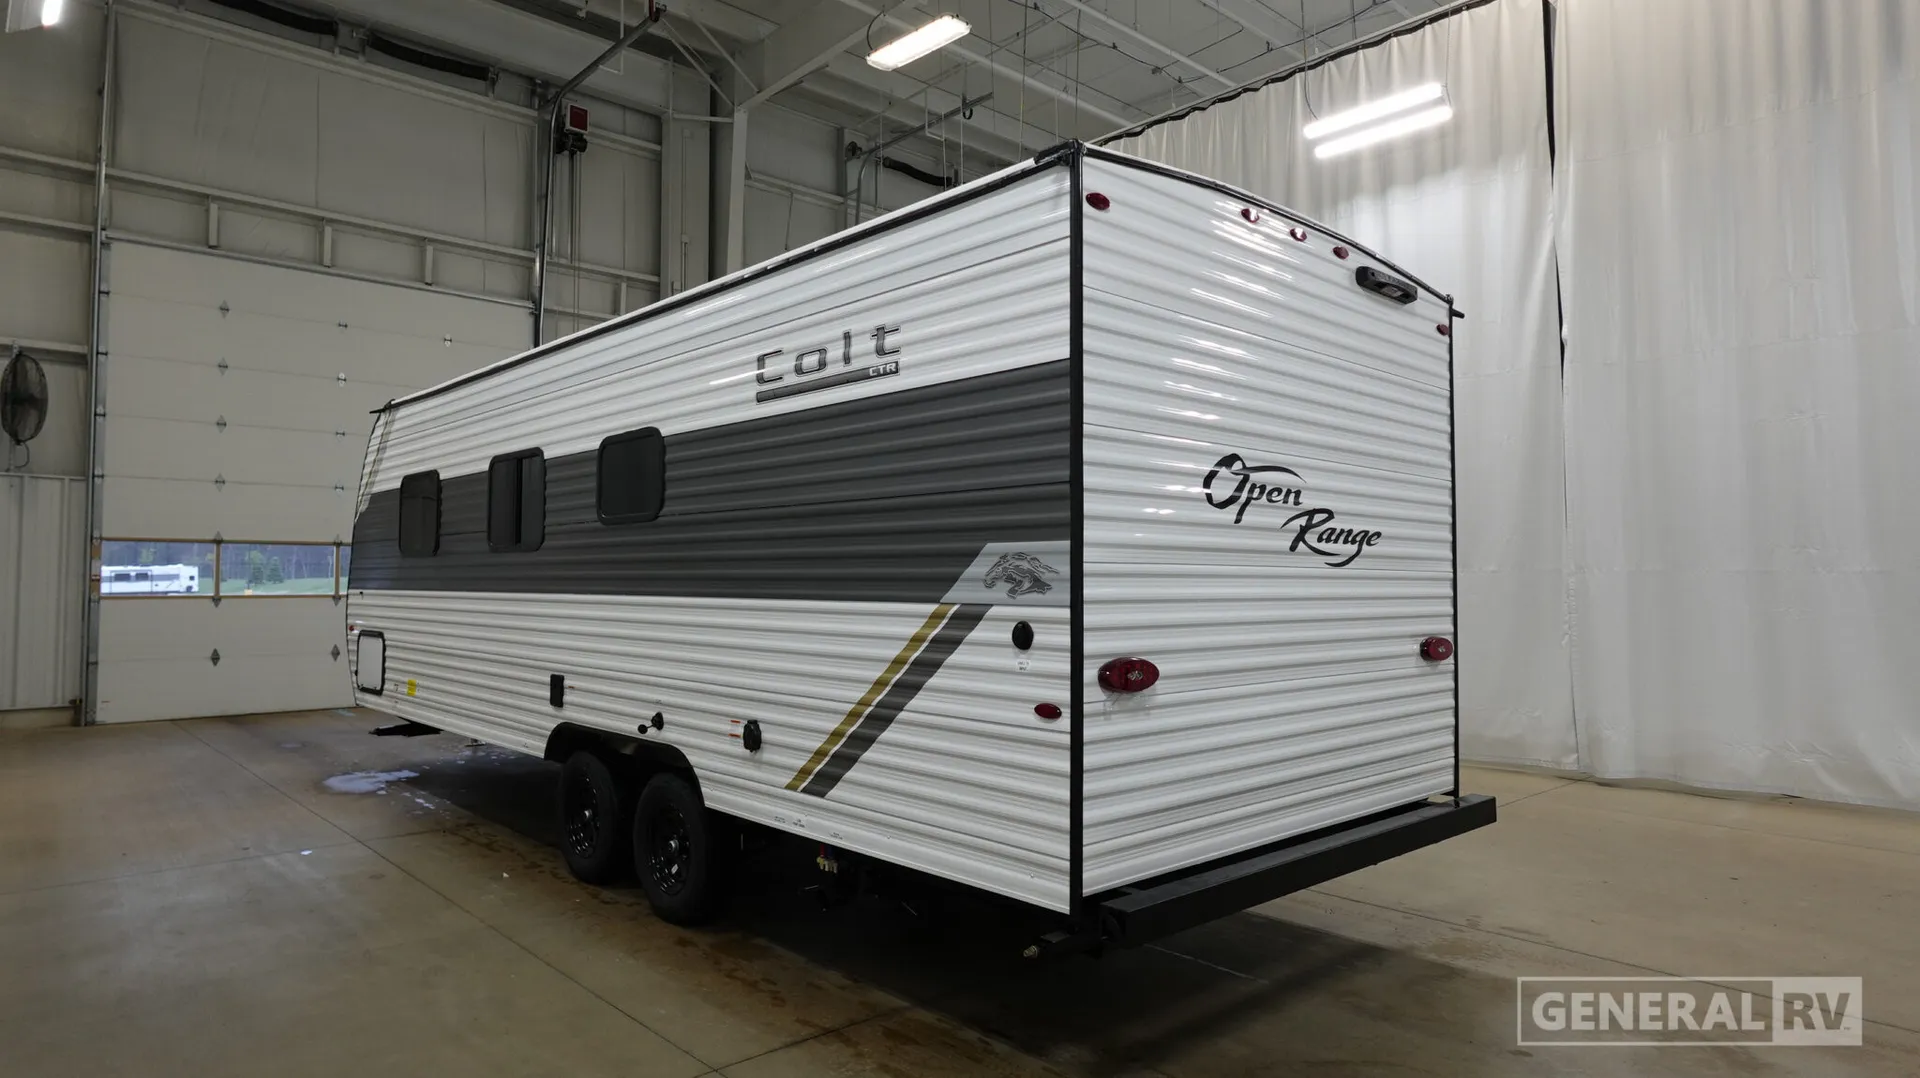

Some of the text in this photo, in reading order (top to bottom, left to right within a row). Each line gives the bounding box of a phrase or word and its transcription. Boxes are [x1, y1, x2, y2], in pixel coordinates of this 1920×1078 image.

[756, 325, 900, 385] Colt
[868, 362, 898, 377] CTR
[1203, 453, 1306, 524] Open
[1280, 508, 1382, 567] Range
